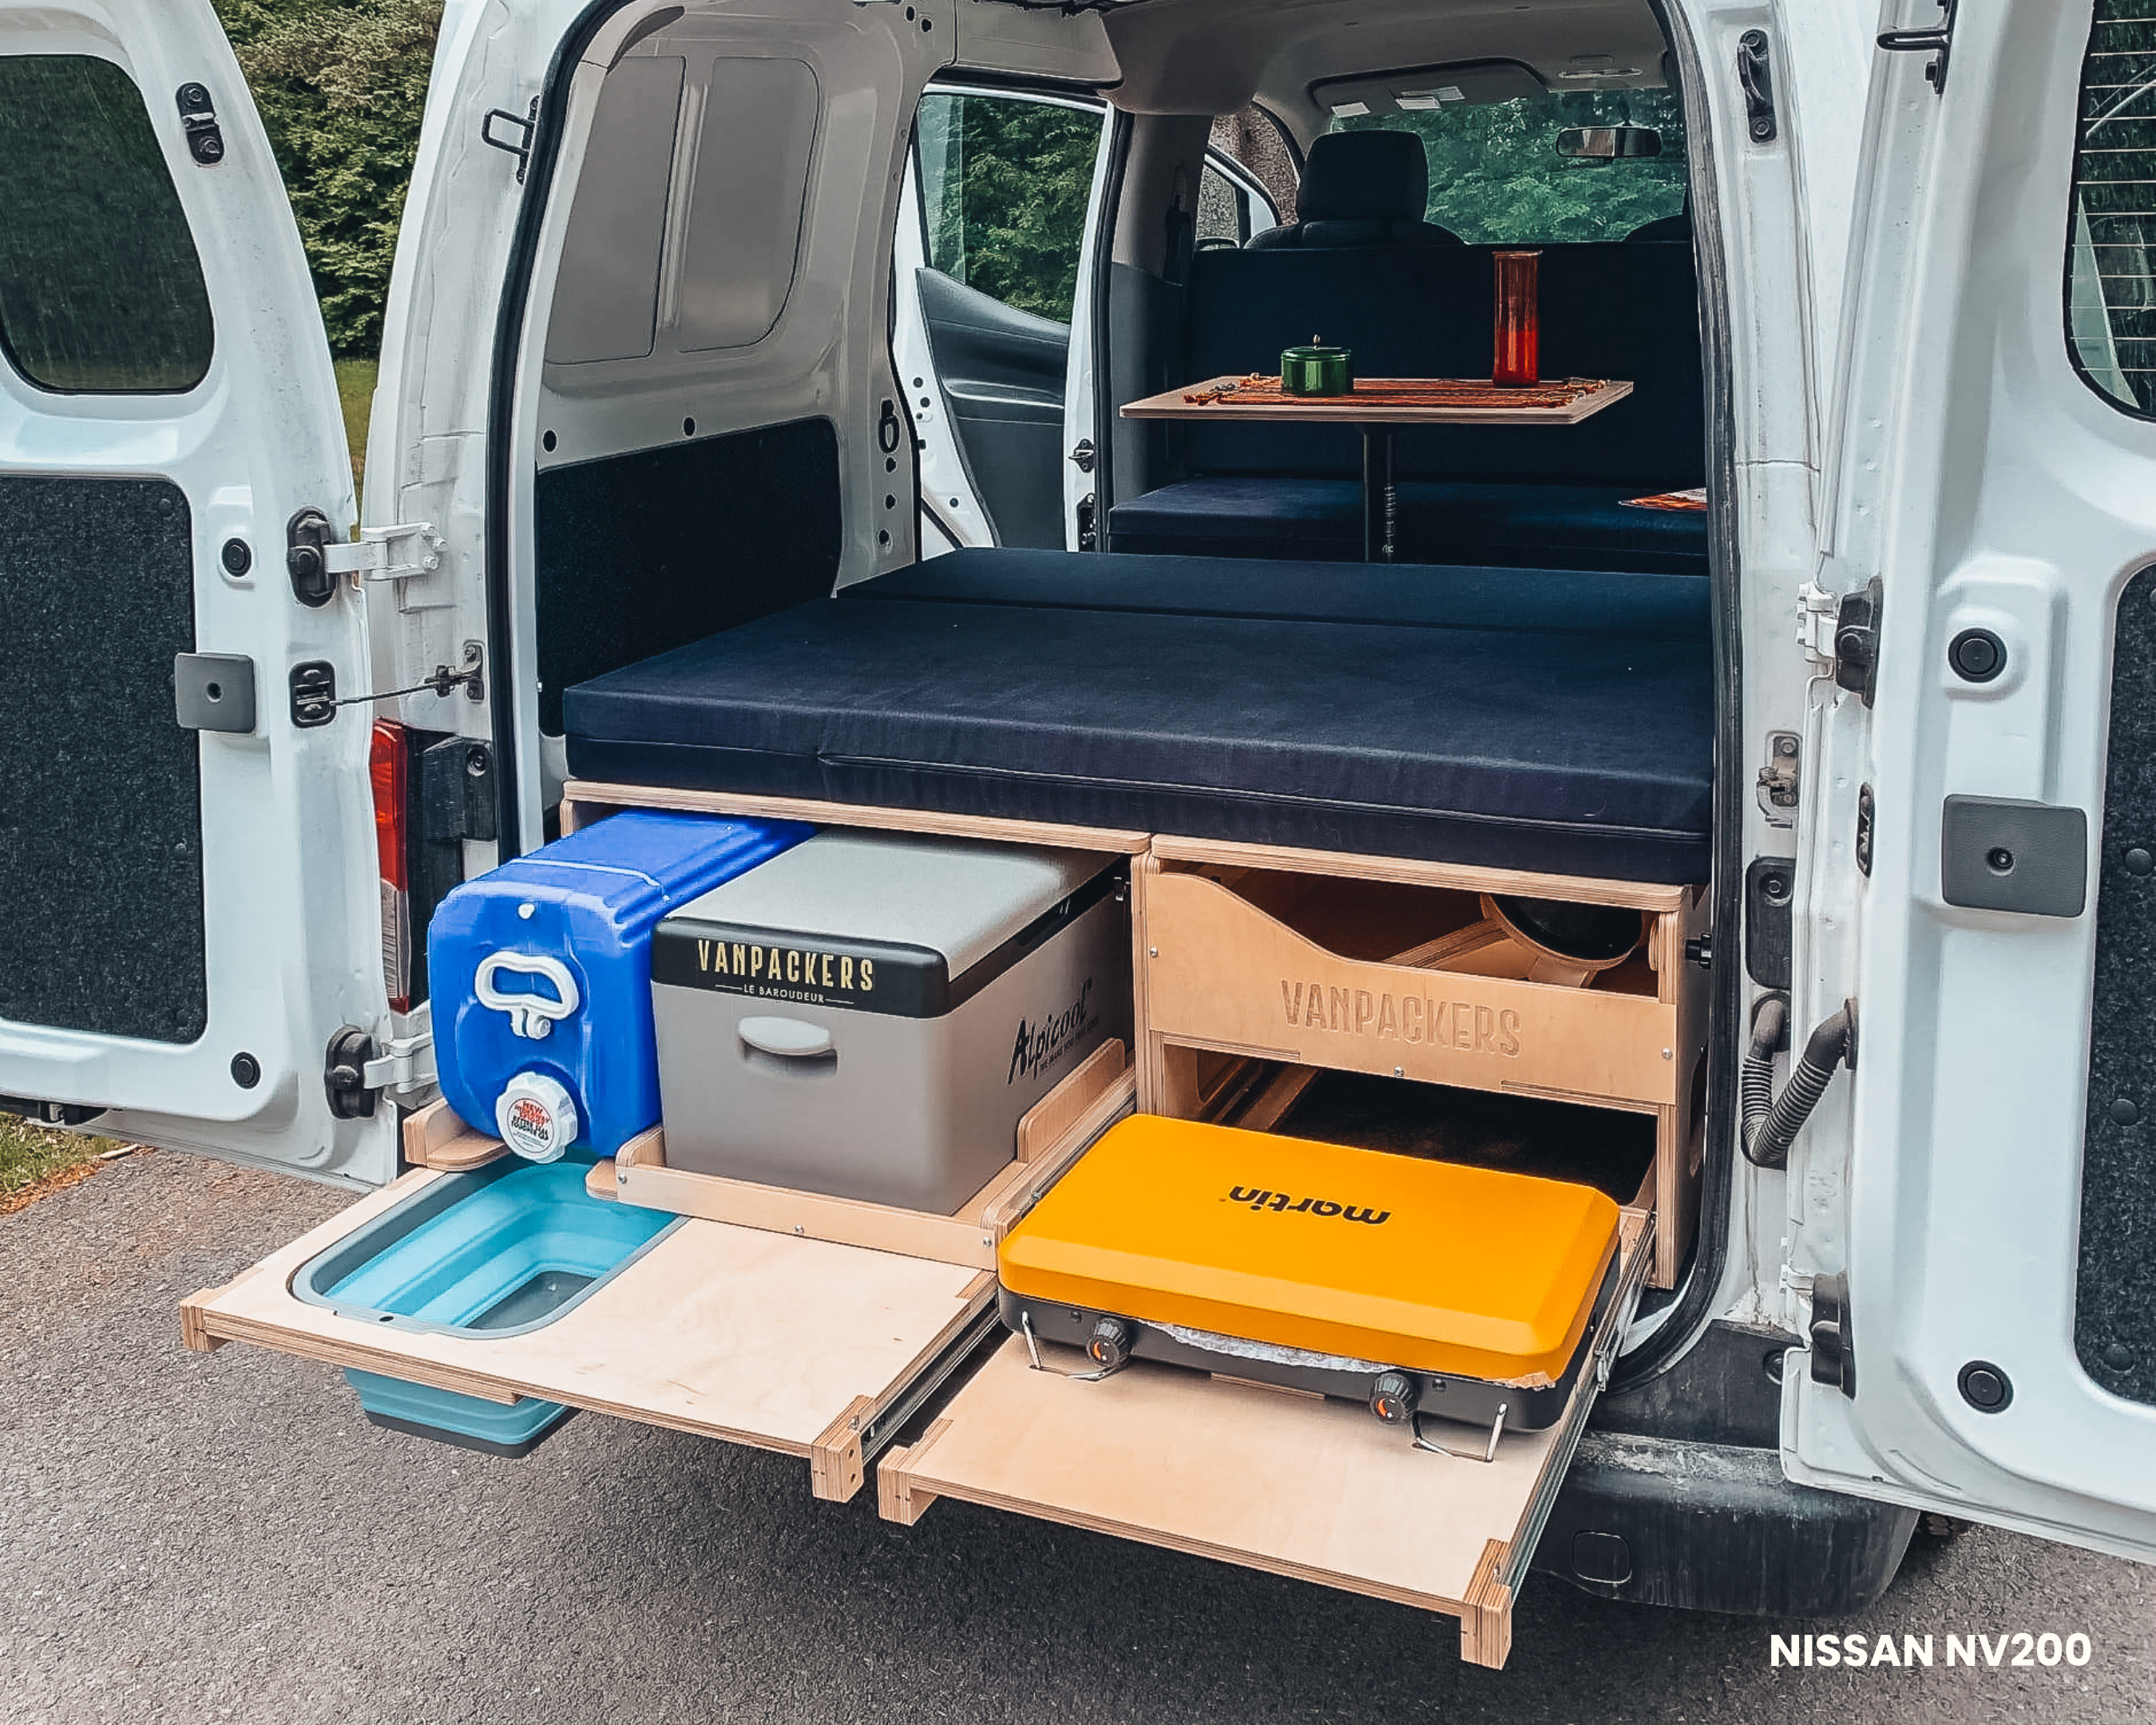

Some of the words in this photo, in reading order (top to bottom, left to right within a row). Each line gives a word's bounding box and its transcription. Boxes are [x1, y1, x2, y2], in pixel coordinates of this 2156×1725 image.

[698, 939, 873, 991] VANPACKERS
[743, 984, 755, 994] LE
[759, 986, 824, 1003] BAROUDEUR
[1281, 979, 1522, 1057] VANPACKERS
[1229, 1185, 1392, 1224] martin
